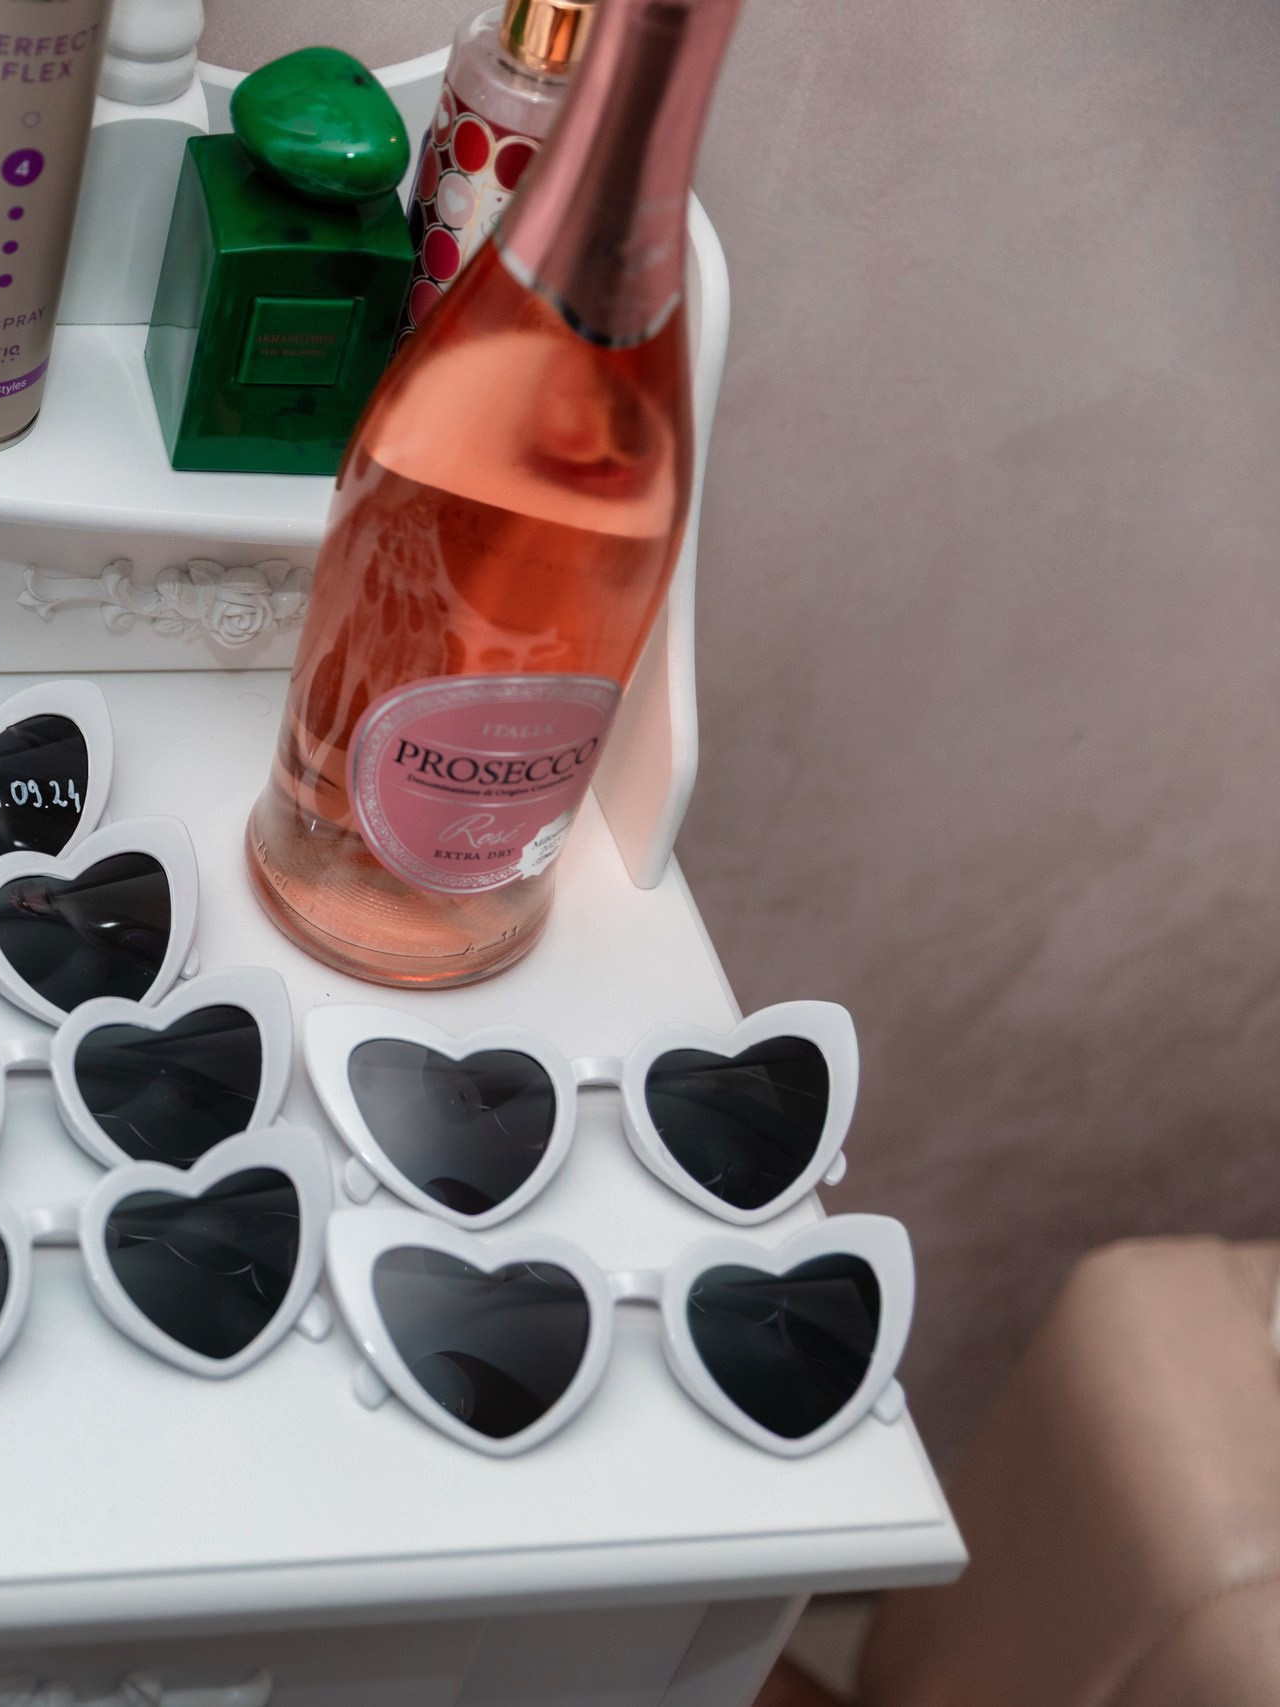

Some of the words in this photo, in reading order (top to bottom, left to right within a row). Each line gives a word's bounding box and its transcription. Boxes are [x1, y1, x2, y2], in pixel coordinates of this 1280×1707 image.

[1, 59, 74, 84] FLEX
[14, 160, 31, 177] 4
[482, 723, 555, 739] ITALIA
[393, 736, 599, 786] PROSECCO
[434, 849, 481, 861] EXTRA
[487, 848, 516, 860] DRY
